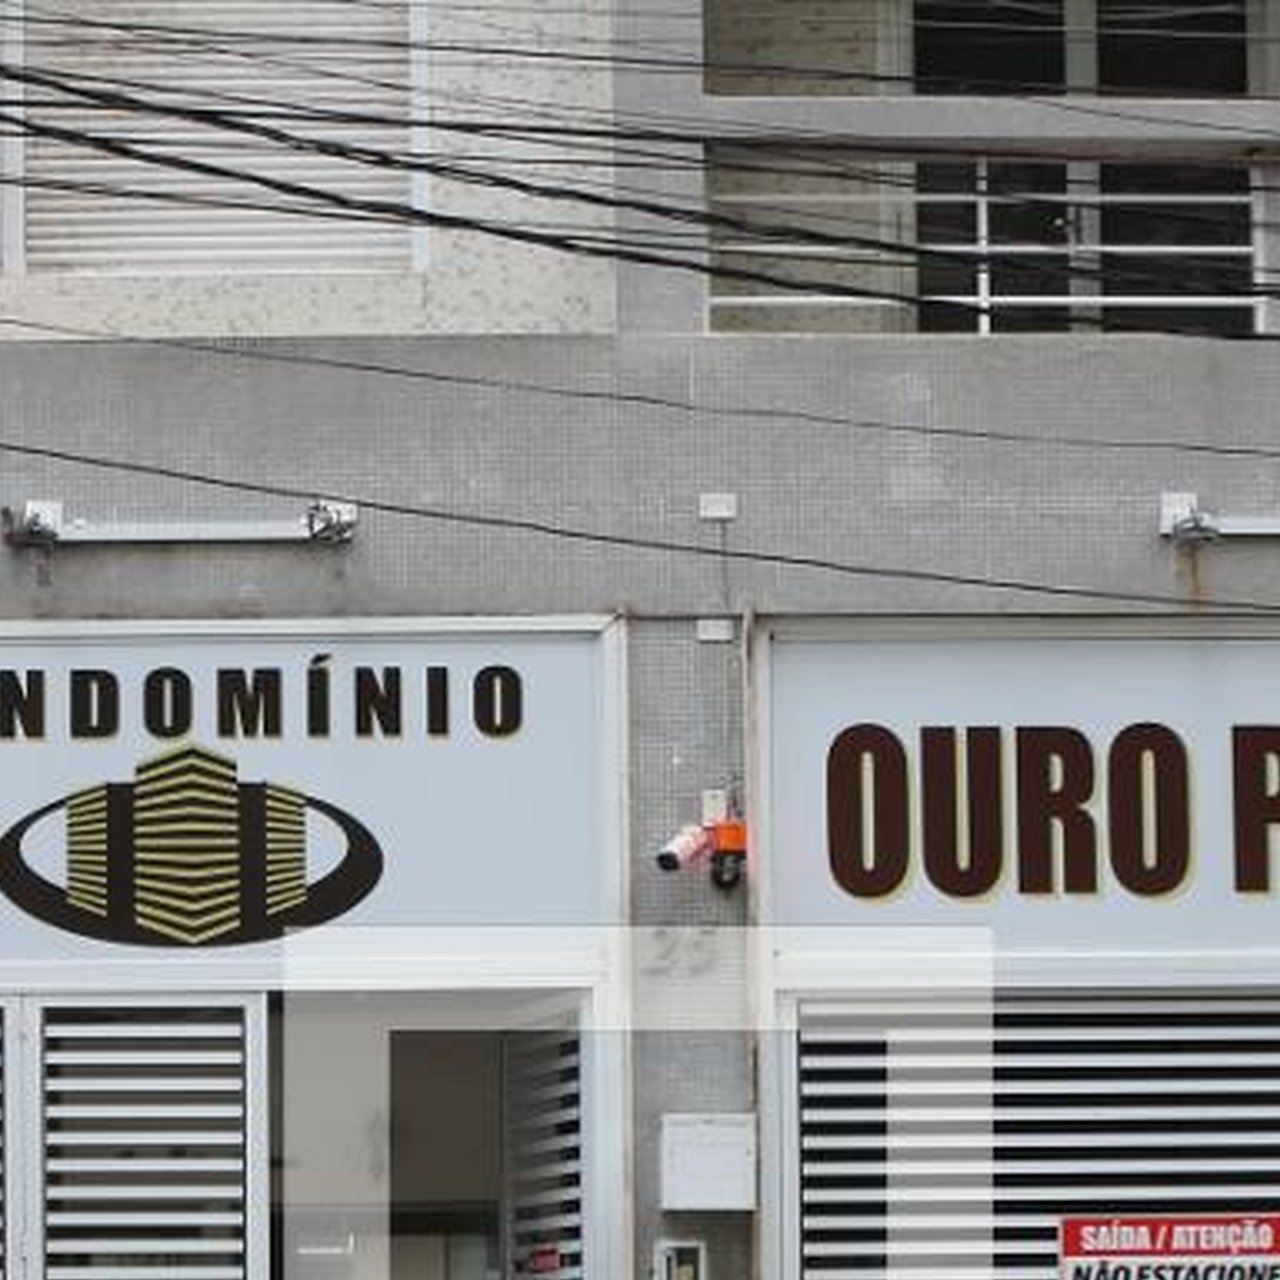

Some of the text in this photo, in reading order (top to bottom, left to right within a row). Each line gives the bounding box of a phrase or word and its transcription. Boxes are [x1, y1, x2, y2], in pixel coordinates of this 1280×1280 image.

[826, 720, 1192, 899] OURO
[1080, 1219, 1152, 1250] SAÍDA
[1172, 1219, 1274, 1253] ATENÇÃO
